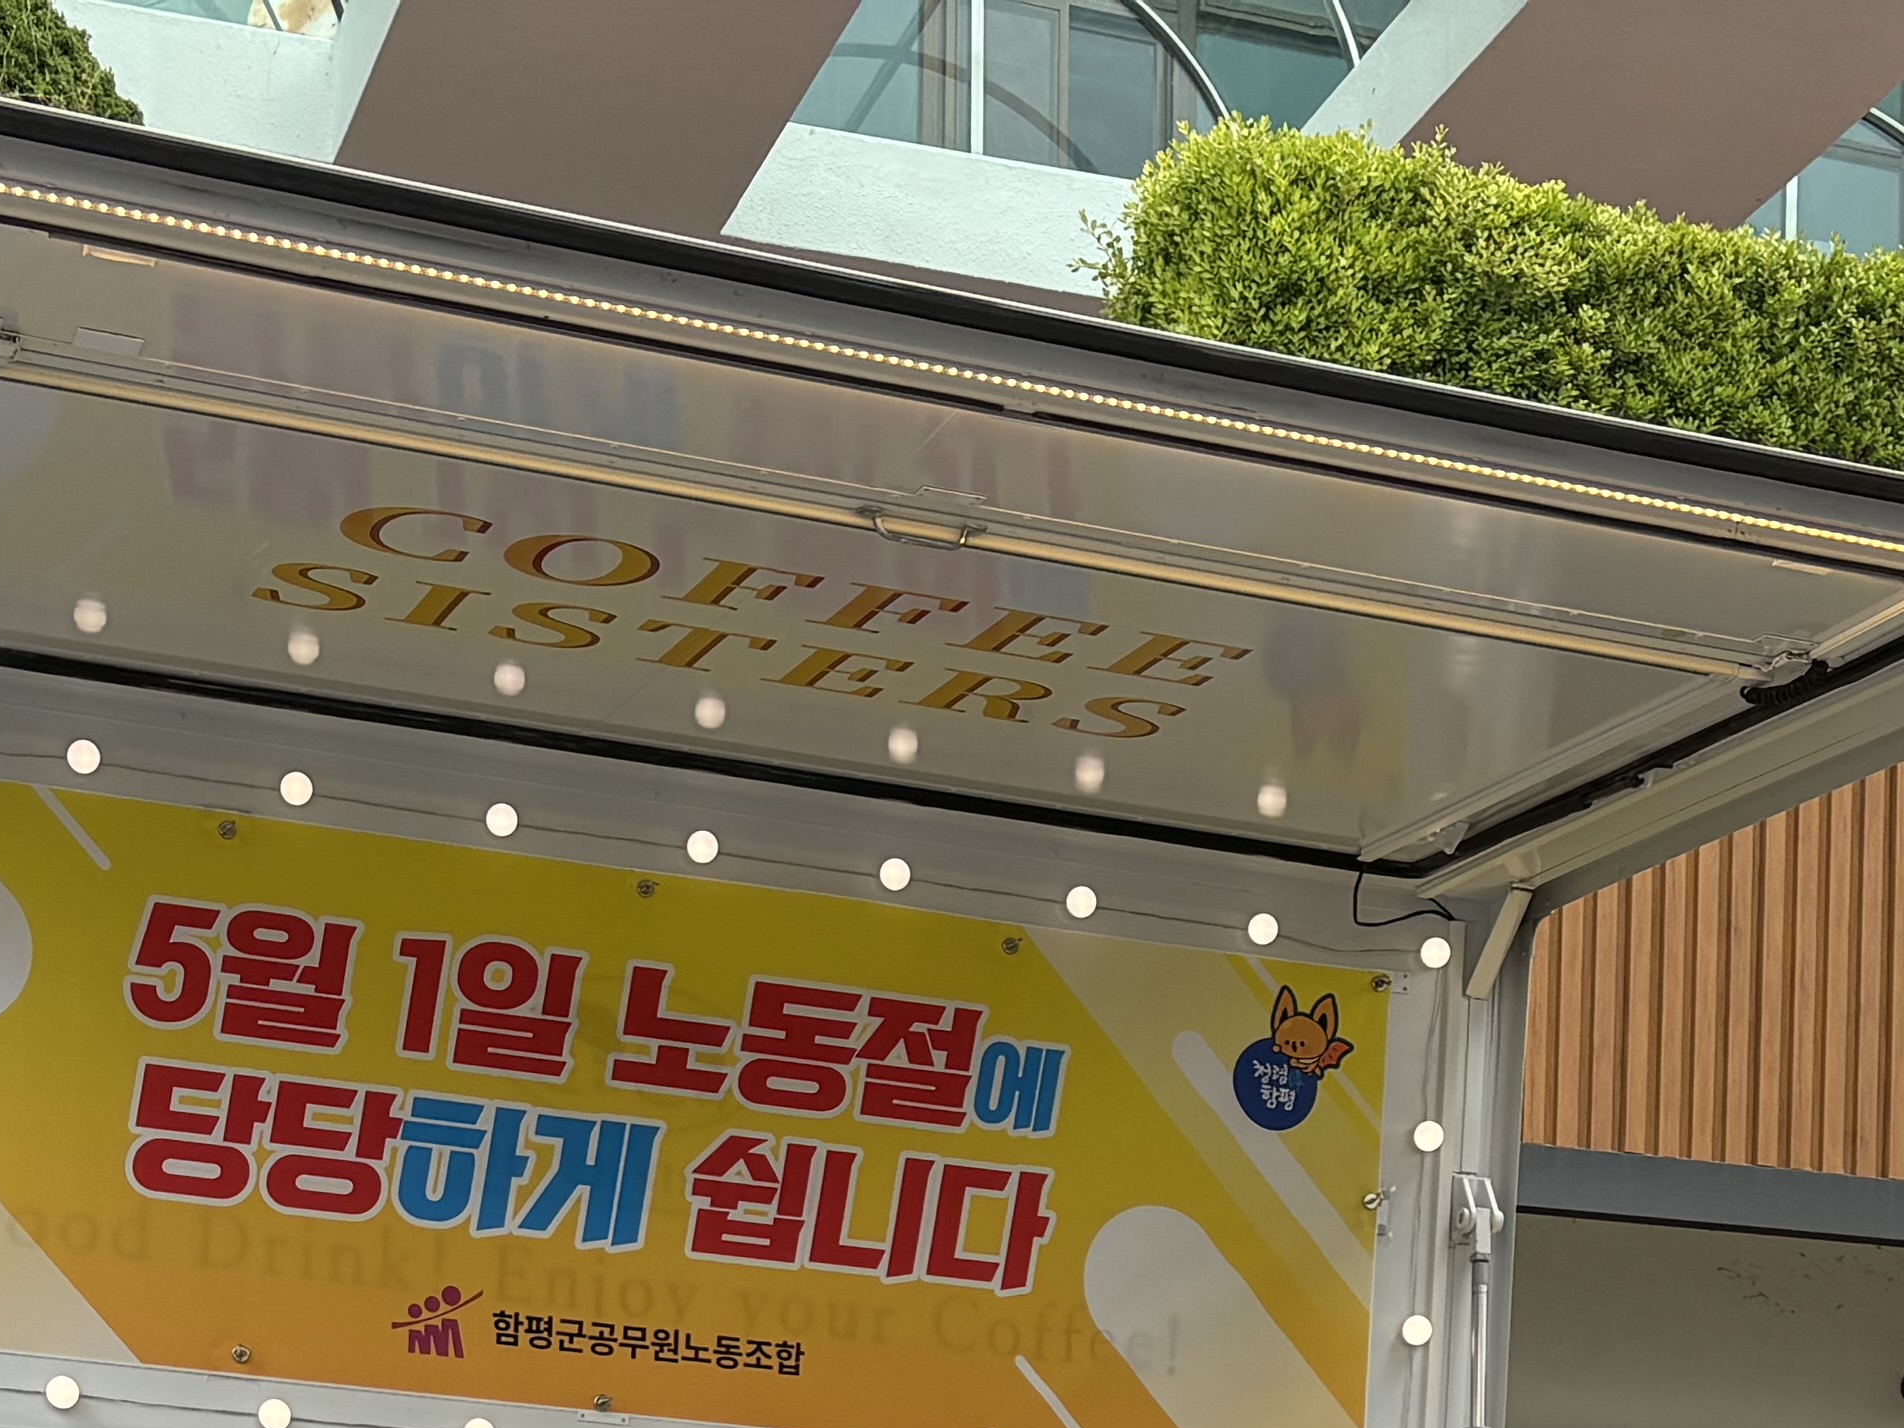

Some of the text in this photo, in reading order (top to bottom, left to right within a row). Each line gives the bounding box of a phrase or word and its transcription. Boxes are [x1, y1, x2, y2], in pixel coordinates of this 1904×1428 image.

[251, 561, 1187, 739] SISTERS
[340, 506, 1253, 686] COFFEE
[126, 898, 1071, 1136] 5월 1일 노동절에
[127, 1061, 1053, 1294] 당당하게 쉽니다
[492, 1310, 805, 1377] 함평군공무원노동조합
